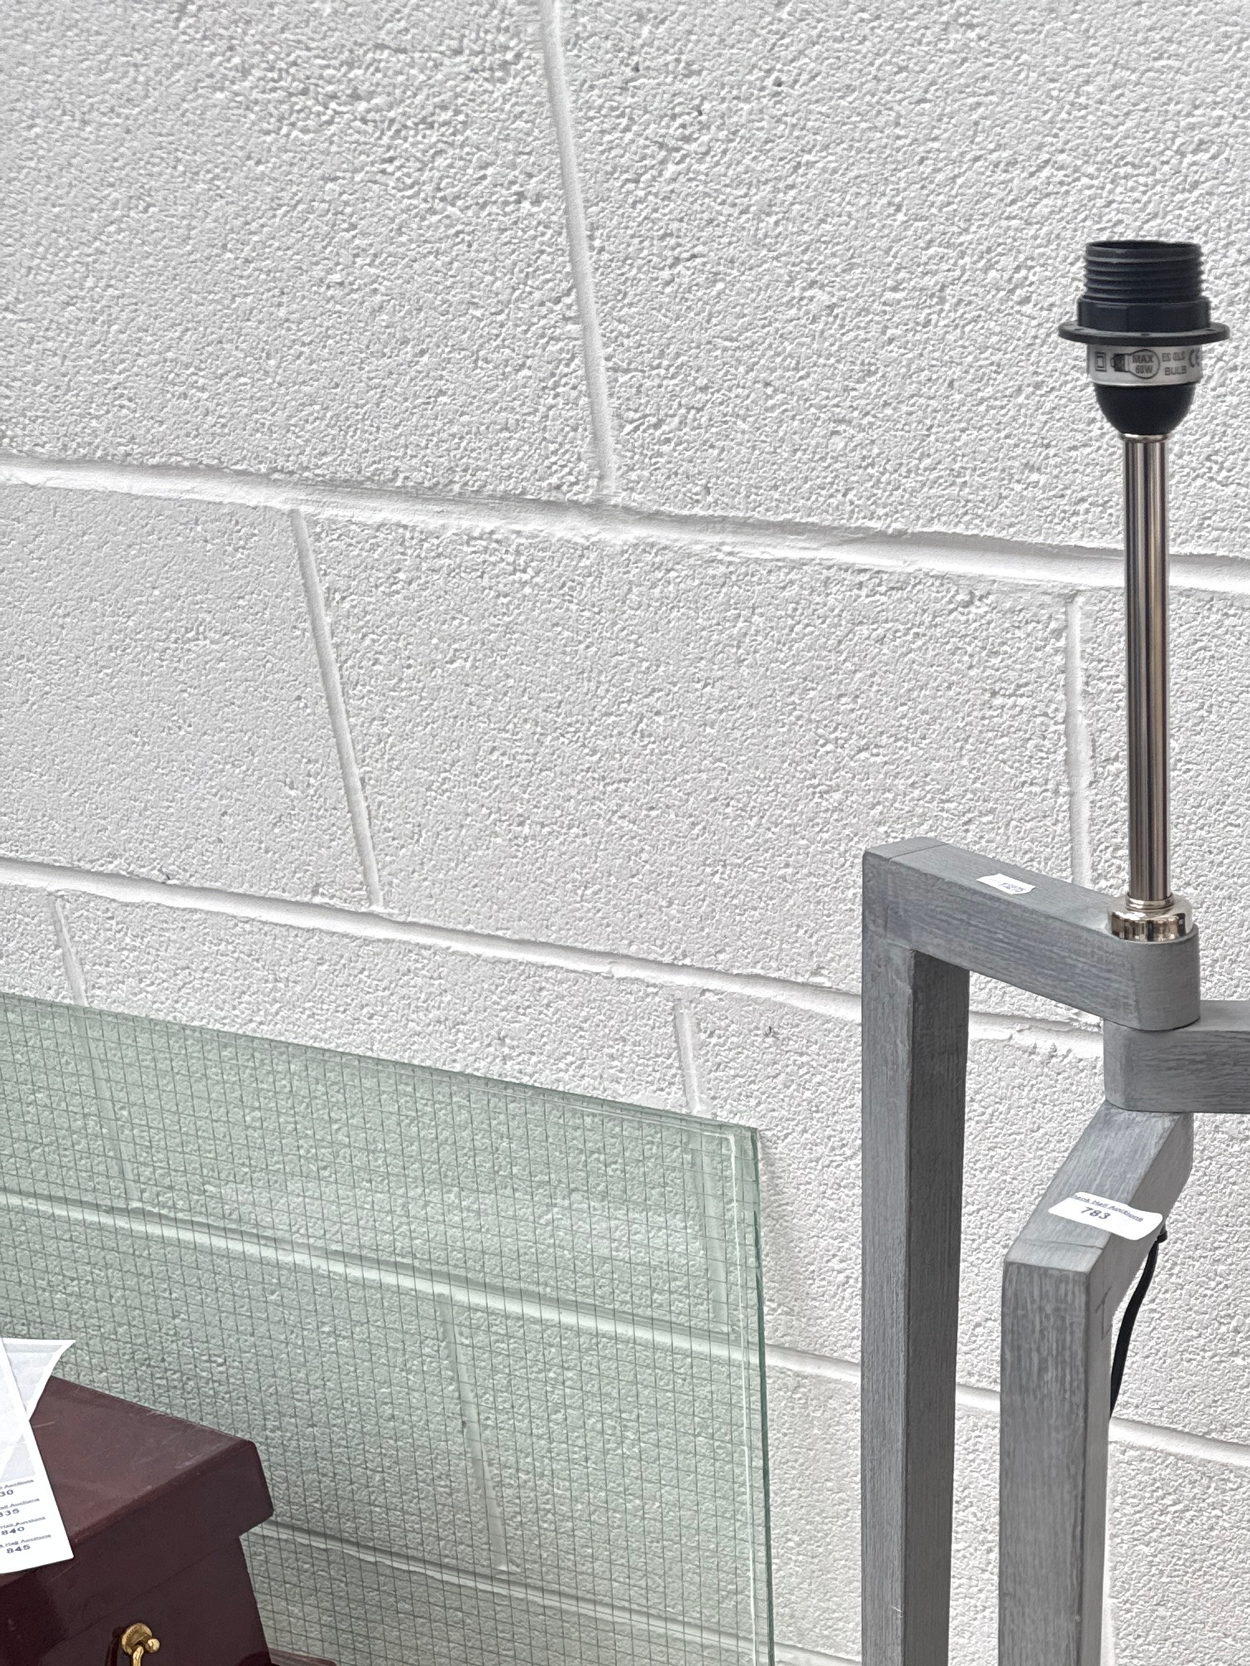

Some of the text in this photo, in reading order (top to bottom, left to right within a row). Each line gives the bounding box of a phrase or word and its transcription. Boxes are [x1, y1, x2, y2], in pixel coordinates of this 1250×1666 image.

[1132, 354, 1154, 363] MAX
[1135, 364, 1154, 374] 60W
[1164, 365, 1187, 376] BULB
[1081, 1206, 1111, 1220] 783
[0, 1489, 14, 1497] 30
[1, 1526, 25, 1536] 840
[6, 1544, 31, 1554] 845
